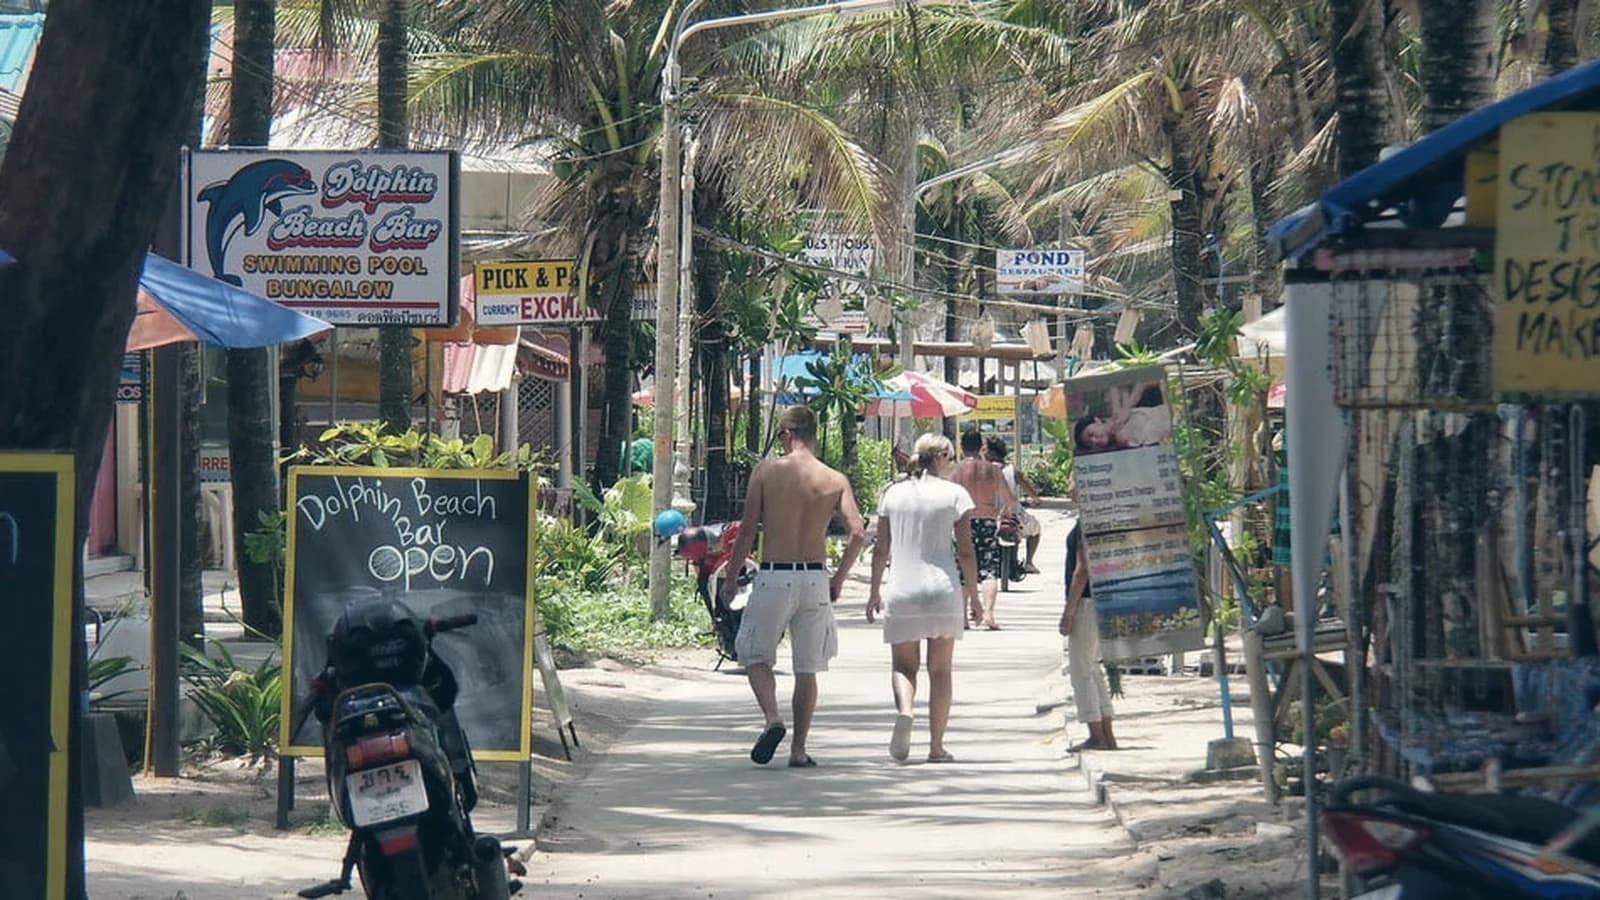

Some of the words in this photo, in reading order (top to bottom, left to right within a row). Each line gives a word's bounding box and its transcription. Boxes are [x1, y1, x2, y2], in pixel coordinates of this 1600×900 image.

[321, 159, 438, 214] Dolphin
[267, 205, 368, 251] Beach
[370, 206, 442, 253] Bar
[243, 255, 361, 274] SWIMMING
[368, 256, 428, 275] POOL
[1014, 252, 1070, 266] POND
[266, 279, 393, 298] BUNGALOW
[482, 268, 529, 290] PICK
[536, 267, 549, 287] &
[482, 303, 519, 316] CURRENCY
[297, 476, 401, 530] Dolphin
[411, 477, 496, 519] Beach
[395, 516, 446, 547] Bar
